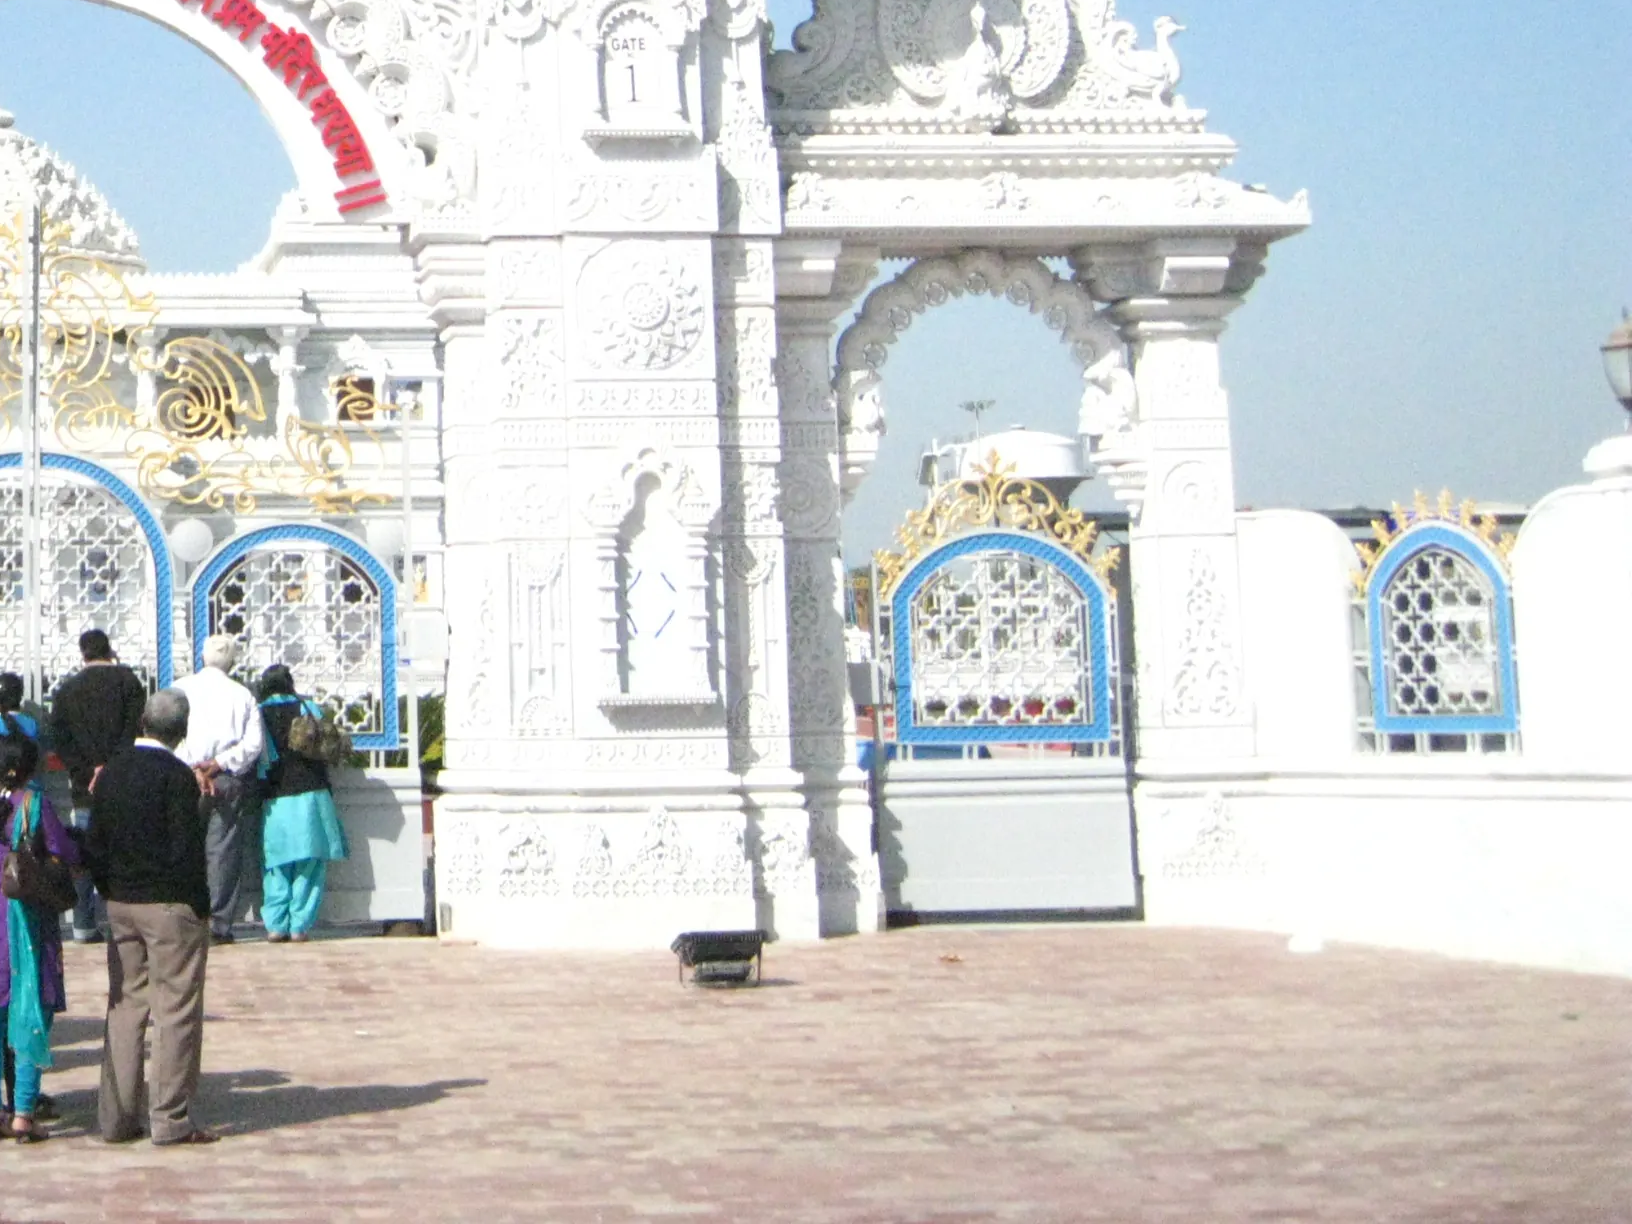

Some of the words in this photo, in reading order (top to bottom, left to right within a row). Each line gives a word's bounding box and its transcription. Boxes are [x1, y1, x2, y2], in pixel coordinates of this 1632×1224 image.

[260, 22, 328, 101] मंदिर
[611, 37, 646, 51] GATE
[624, 64, 642, 102] 1
